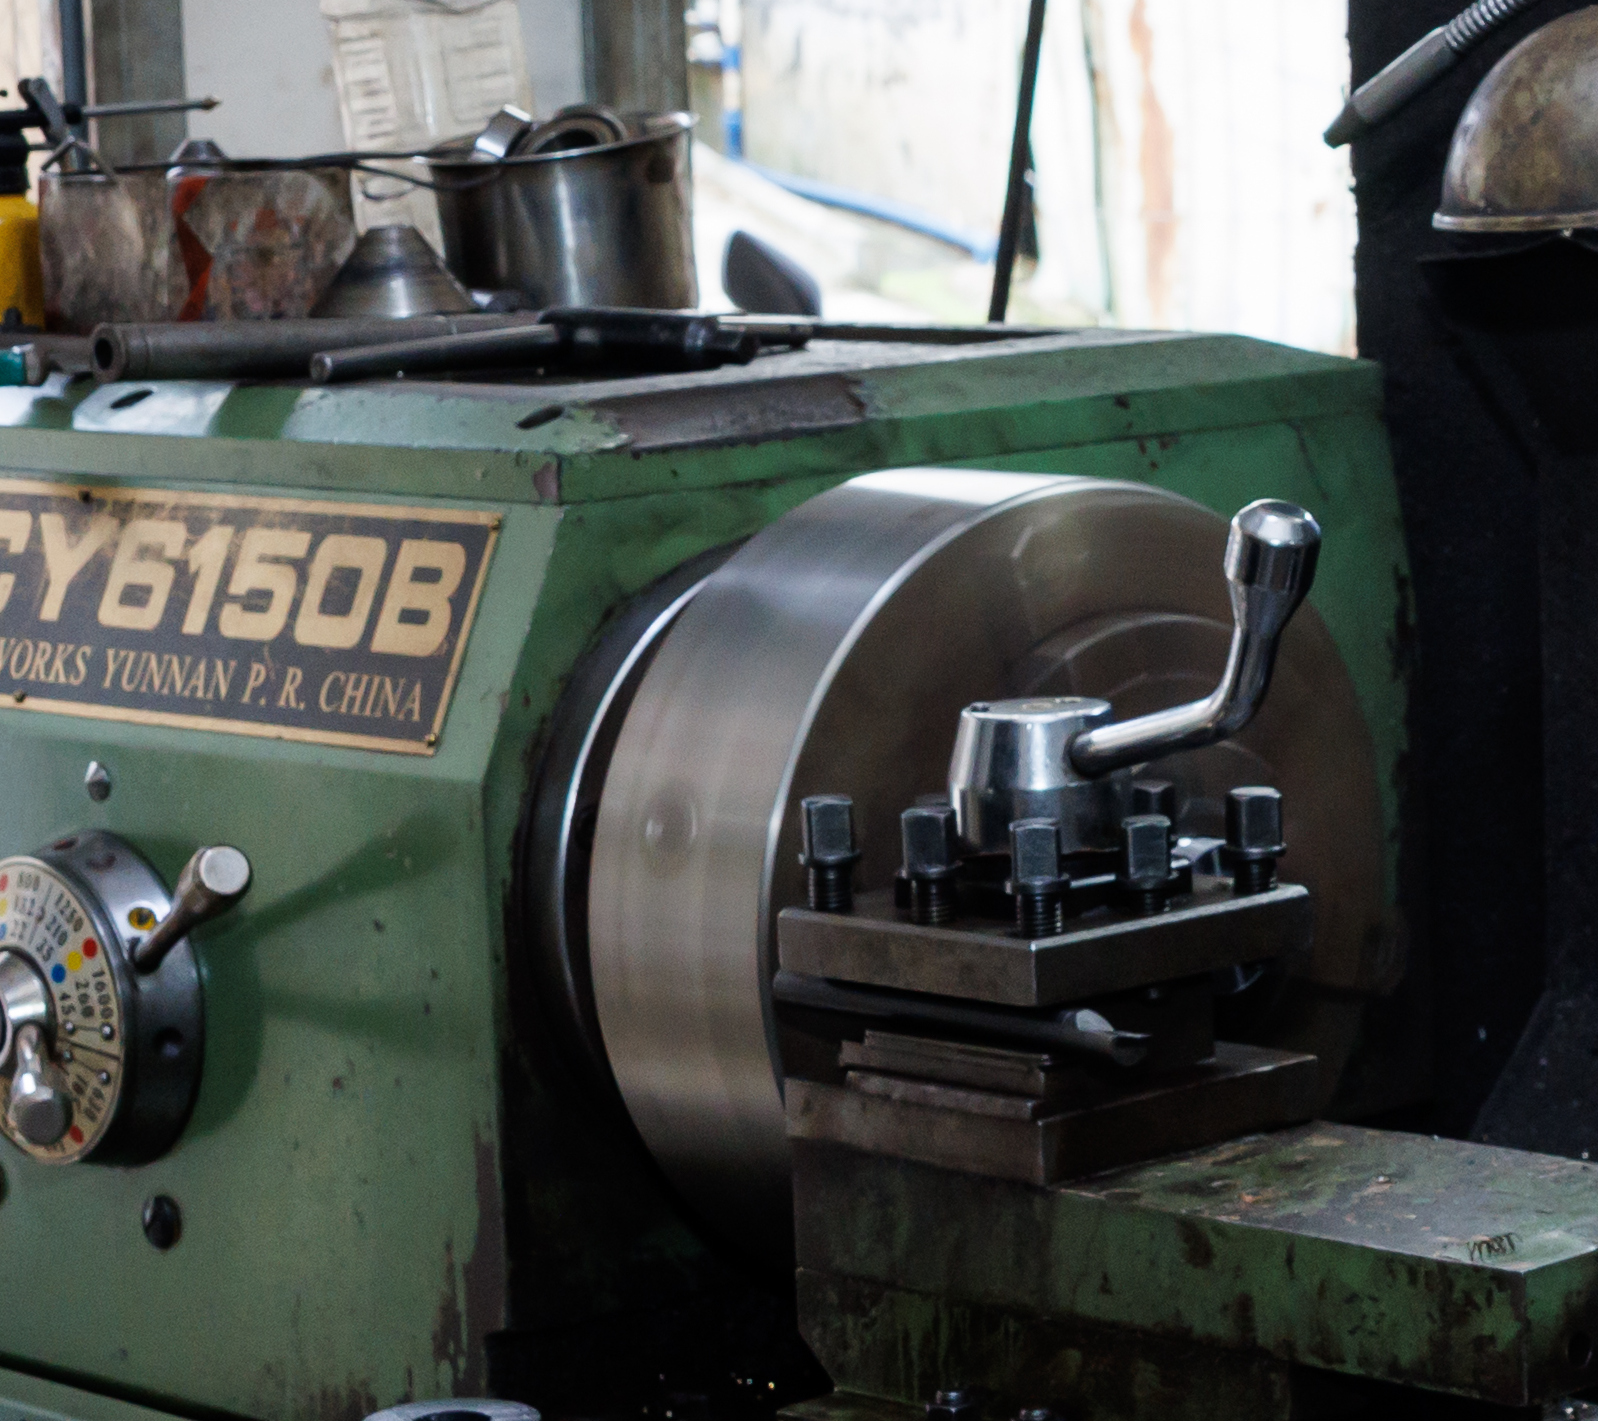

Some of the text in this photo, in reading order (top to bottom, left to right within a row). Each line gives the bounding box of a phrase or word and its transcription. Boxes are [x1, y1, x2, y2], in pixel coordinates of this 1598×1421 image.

[103, 648, 237, 701] YUNNAN
[241, 668, 266, 707] P.
[277, 666, 307, 711] R.
[318, 670, 422, 722] CHINA
